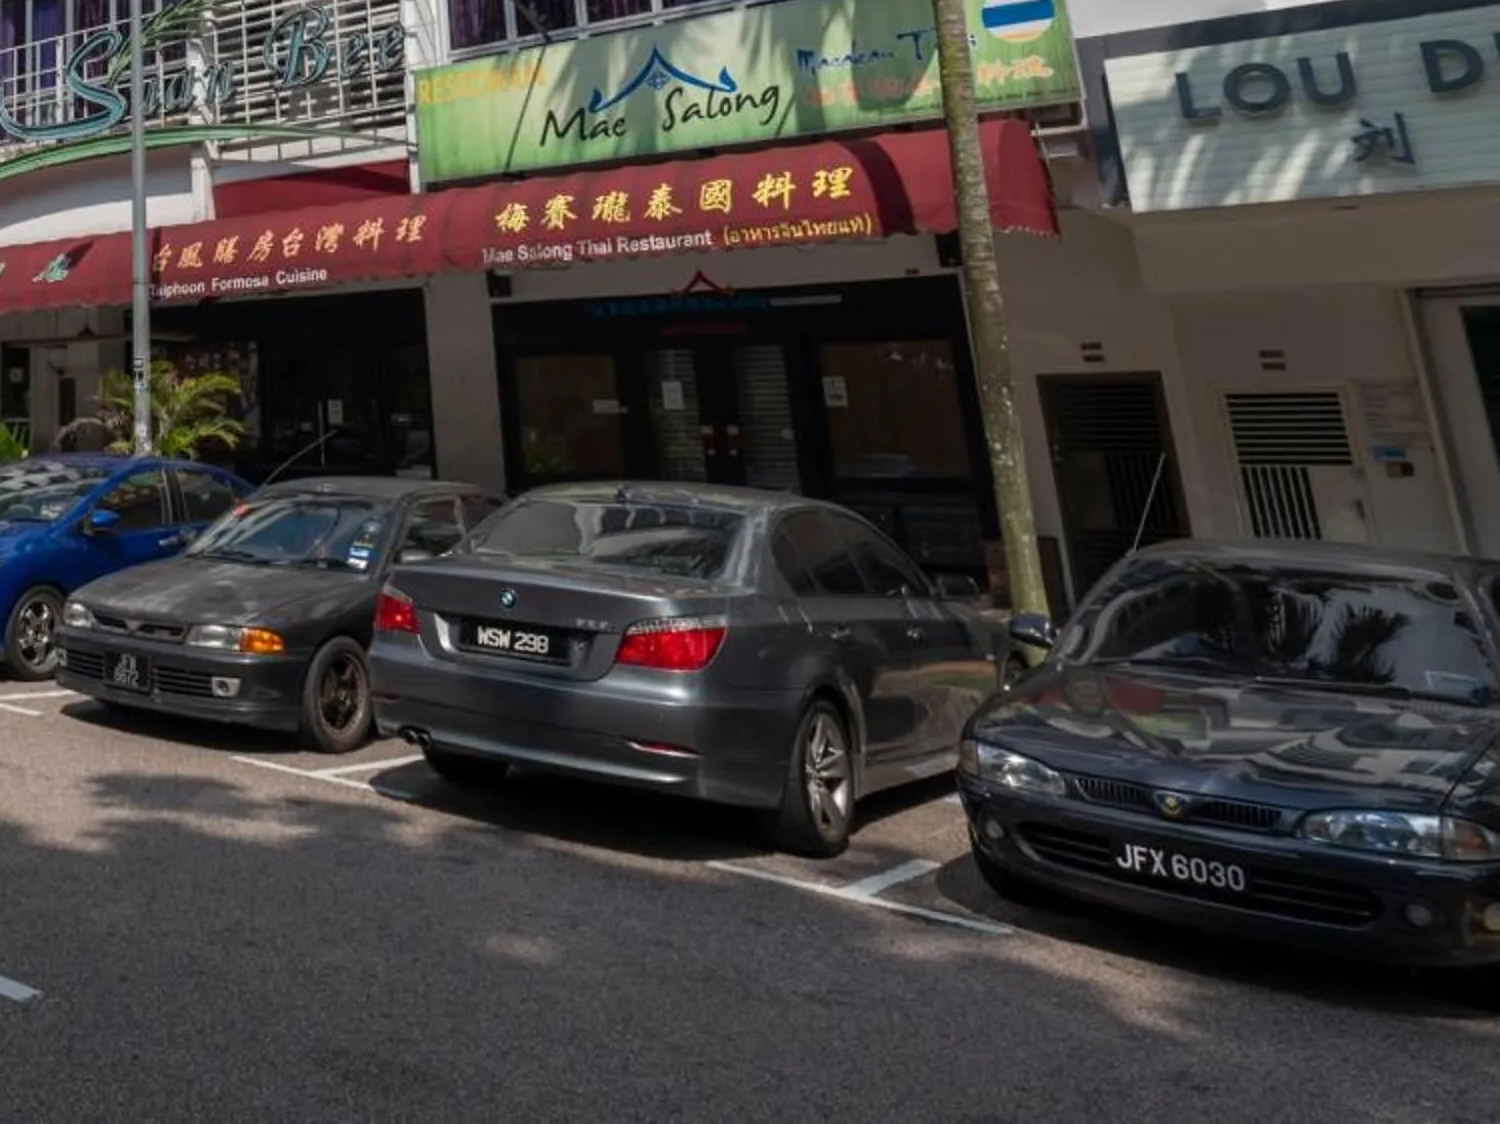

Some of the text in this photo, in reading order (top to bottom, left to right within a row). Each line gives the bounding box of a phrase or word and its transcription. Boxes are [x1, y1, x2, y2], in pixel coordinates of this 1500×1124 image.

[264, 4, 406, 88] Bee
[896, 27, 978, 60] Ti
[1175, 31, 1500, 119] LOU D
[540, 109, 626, 147] Mae
[661, 84, 780, 133] Salong
[483, 232, 713, 264] Mae Salong Thai Restaurant
[211, 277, 269, 292] Formosa
[275, 267, 329, 286] Cuisine
[514, 630, 550, 654] 298
[1115, 843, 1246, 892] JFX 6030
